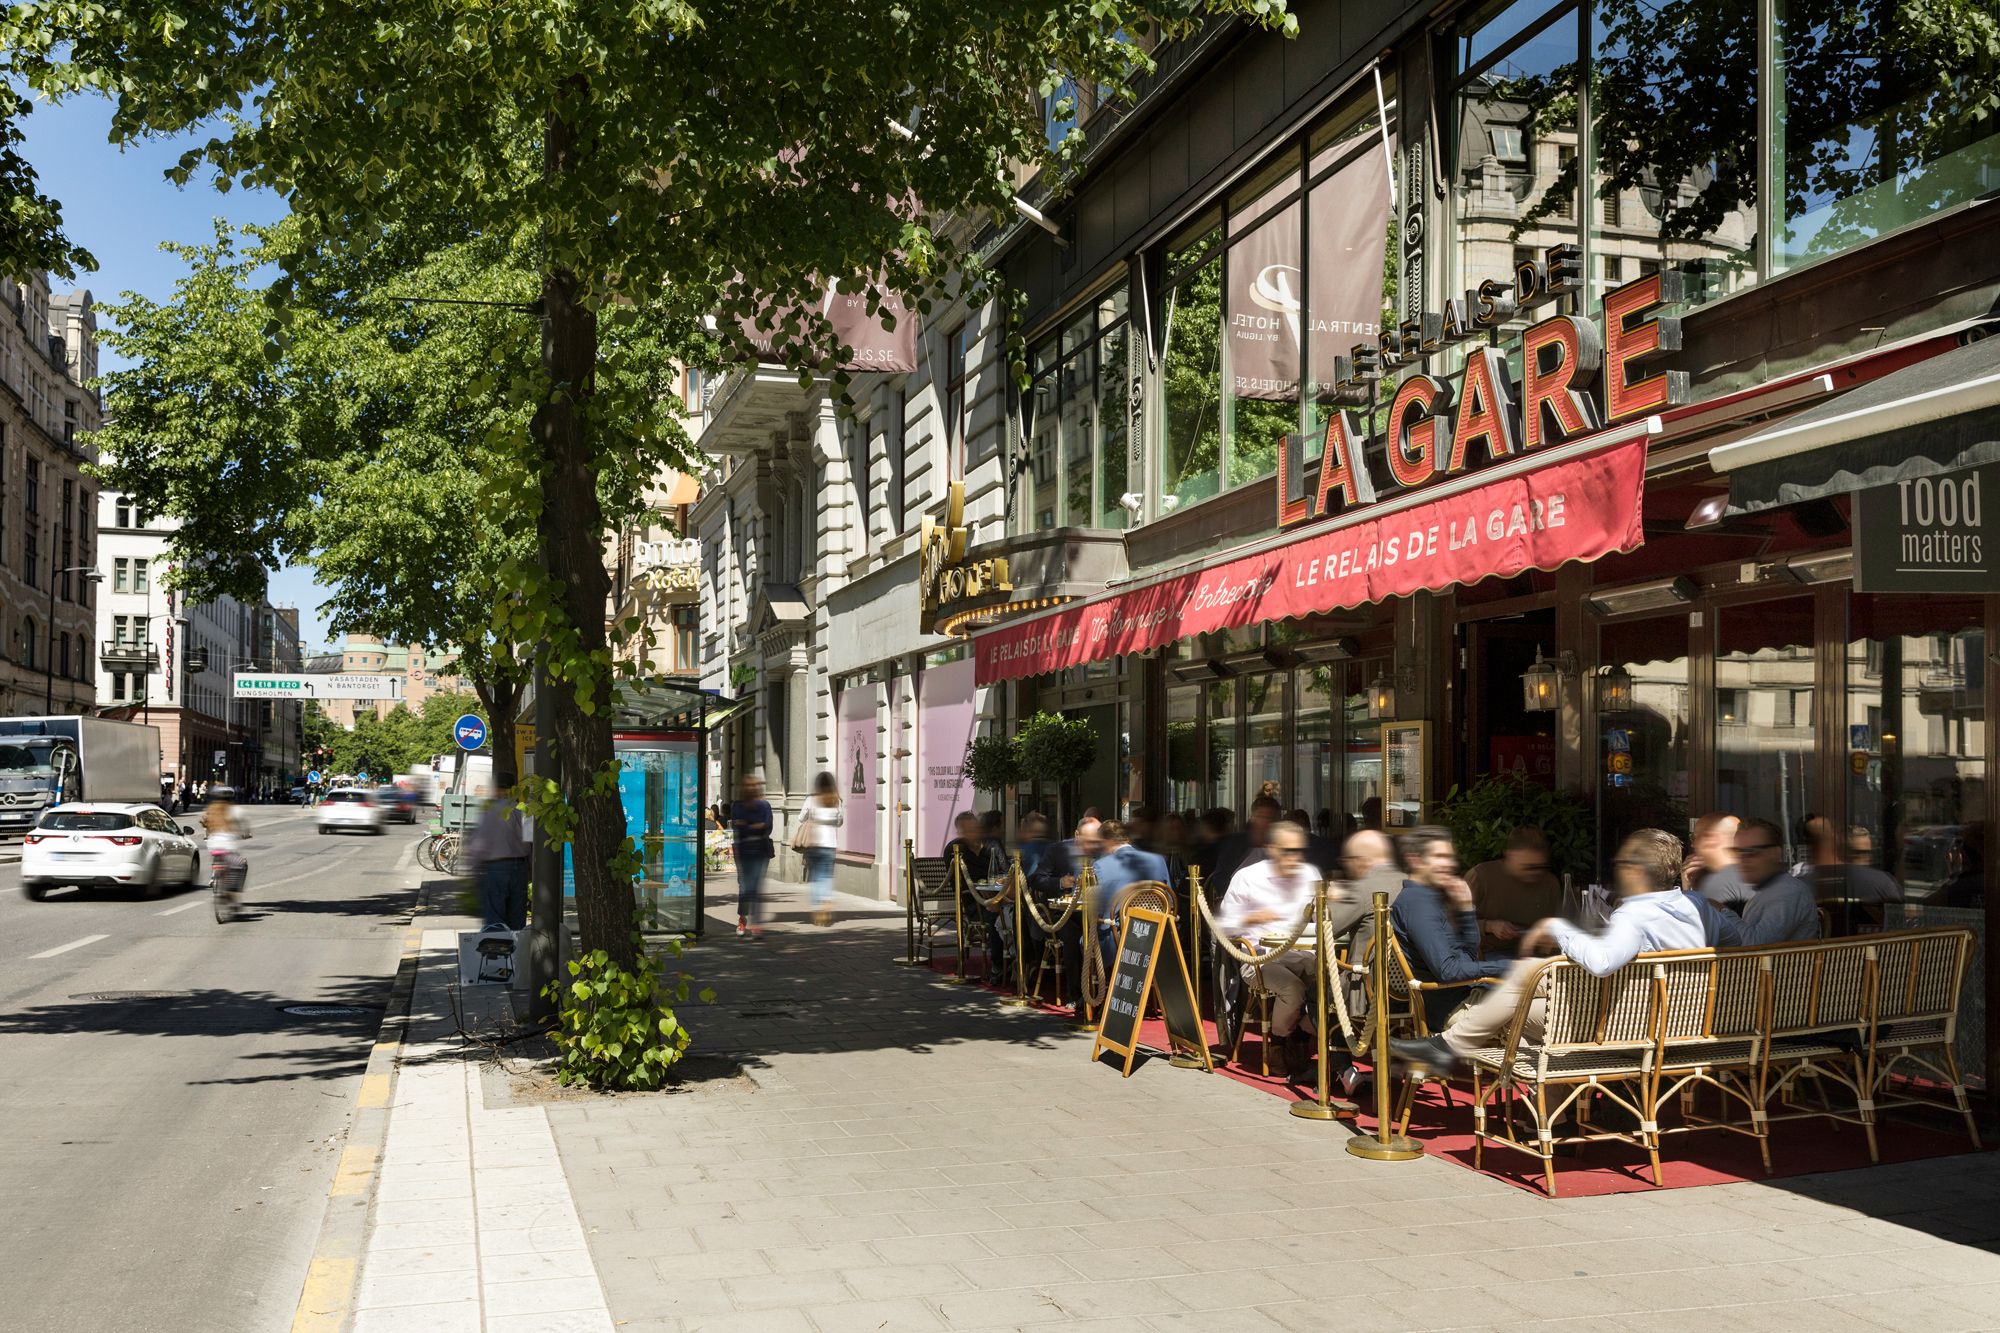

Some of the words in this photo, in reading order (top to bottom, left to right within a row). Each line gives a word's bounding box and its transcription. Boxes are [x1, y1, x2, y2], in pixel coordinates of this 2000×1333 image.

[847, 299, 858, 308] BY
[1334, 342, 1382, 390] LE
[1378, 277, 1512, 370] RELAIS
[1515, 243, 1584, 306] DE
[1277, 409, 1376, 528] LA
[1386, 269, 1690, 488] GARE
[1295, 559, 1320, 587] LE
[1324, 536, 1400, 581] RELAIS
[1406, 525, 1440, 561] DE
[1448, 515, 1478, 551] LA
[1486, 494, 1566, 541] GARE
[1902, 530, 1982, 563] matters
[938, 557, 1014, 604] HOTEL
[239, 680, 251, 688] E4
[257, 680, 273, 689] E18
[280, 681, 298, 689] E20
